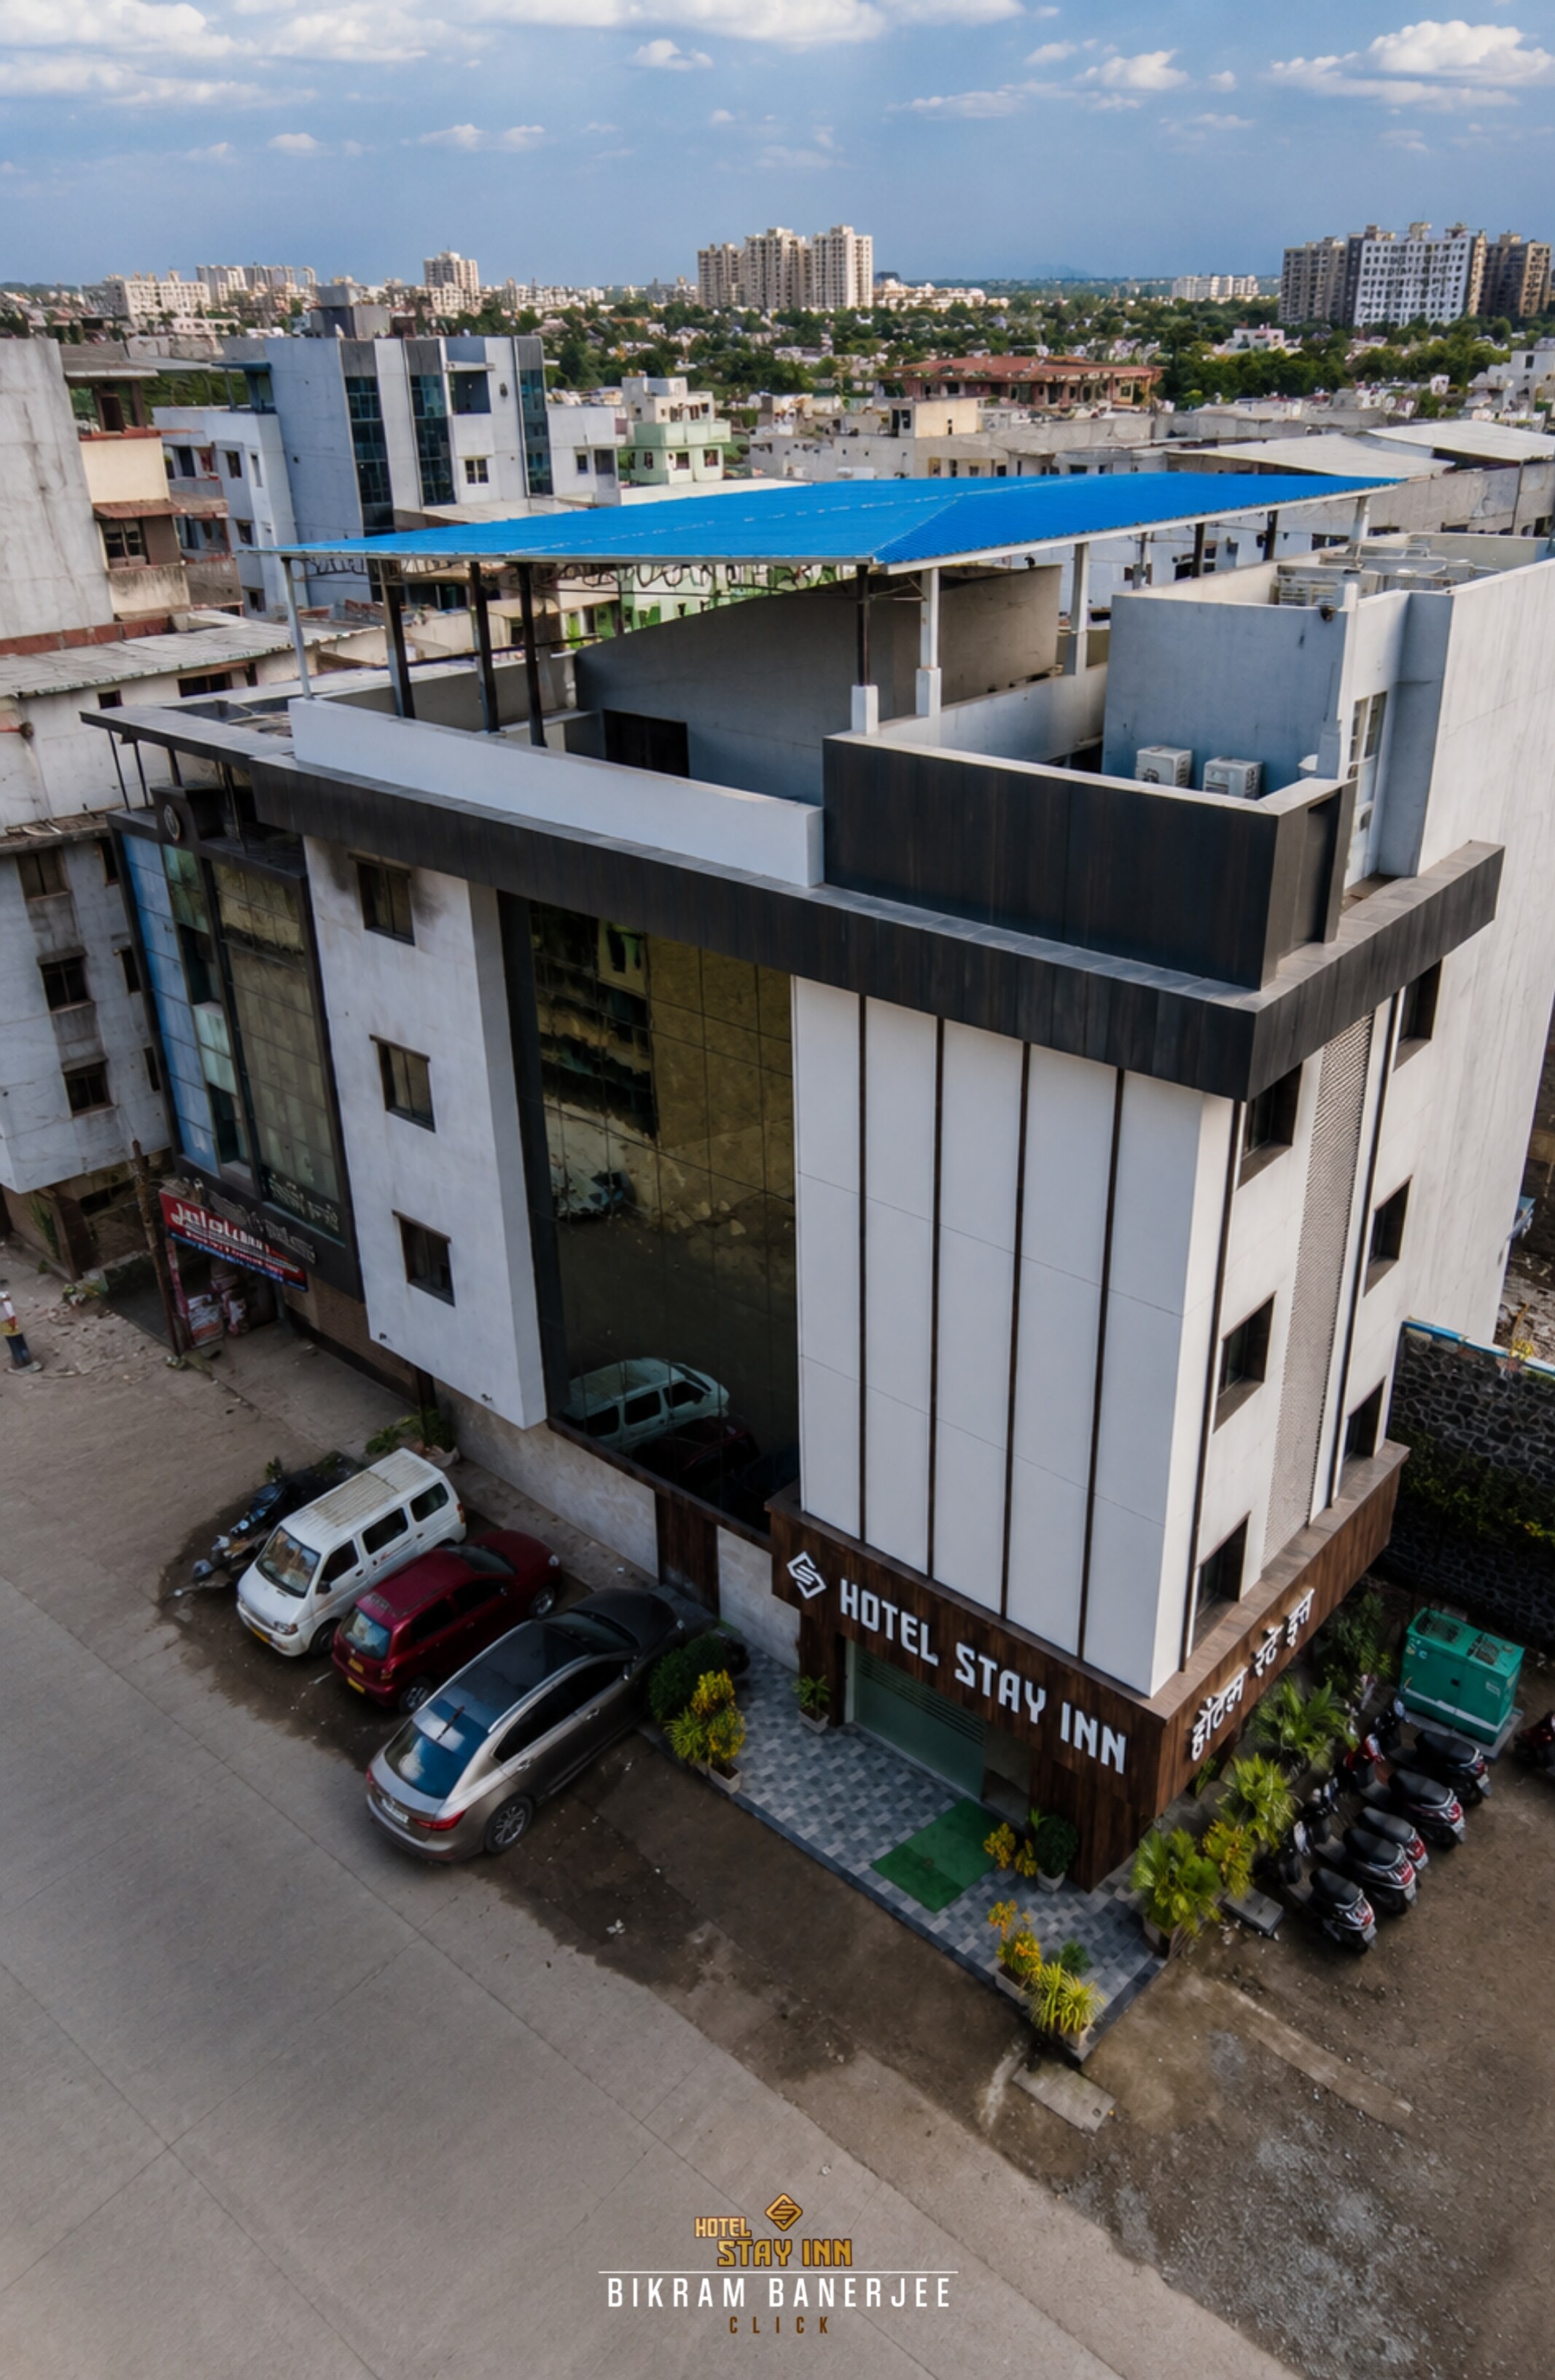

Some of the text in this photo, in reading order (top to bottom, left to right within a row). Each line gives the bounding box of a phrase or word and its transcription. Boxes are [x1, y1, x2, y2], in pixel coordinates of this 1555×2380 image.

[840, 1578, 1127, 1774] HOTEL STAY INN
[1191, 1667, 1248, 1761] होटल
[1286, 1588, 1314, 1647] इन
